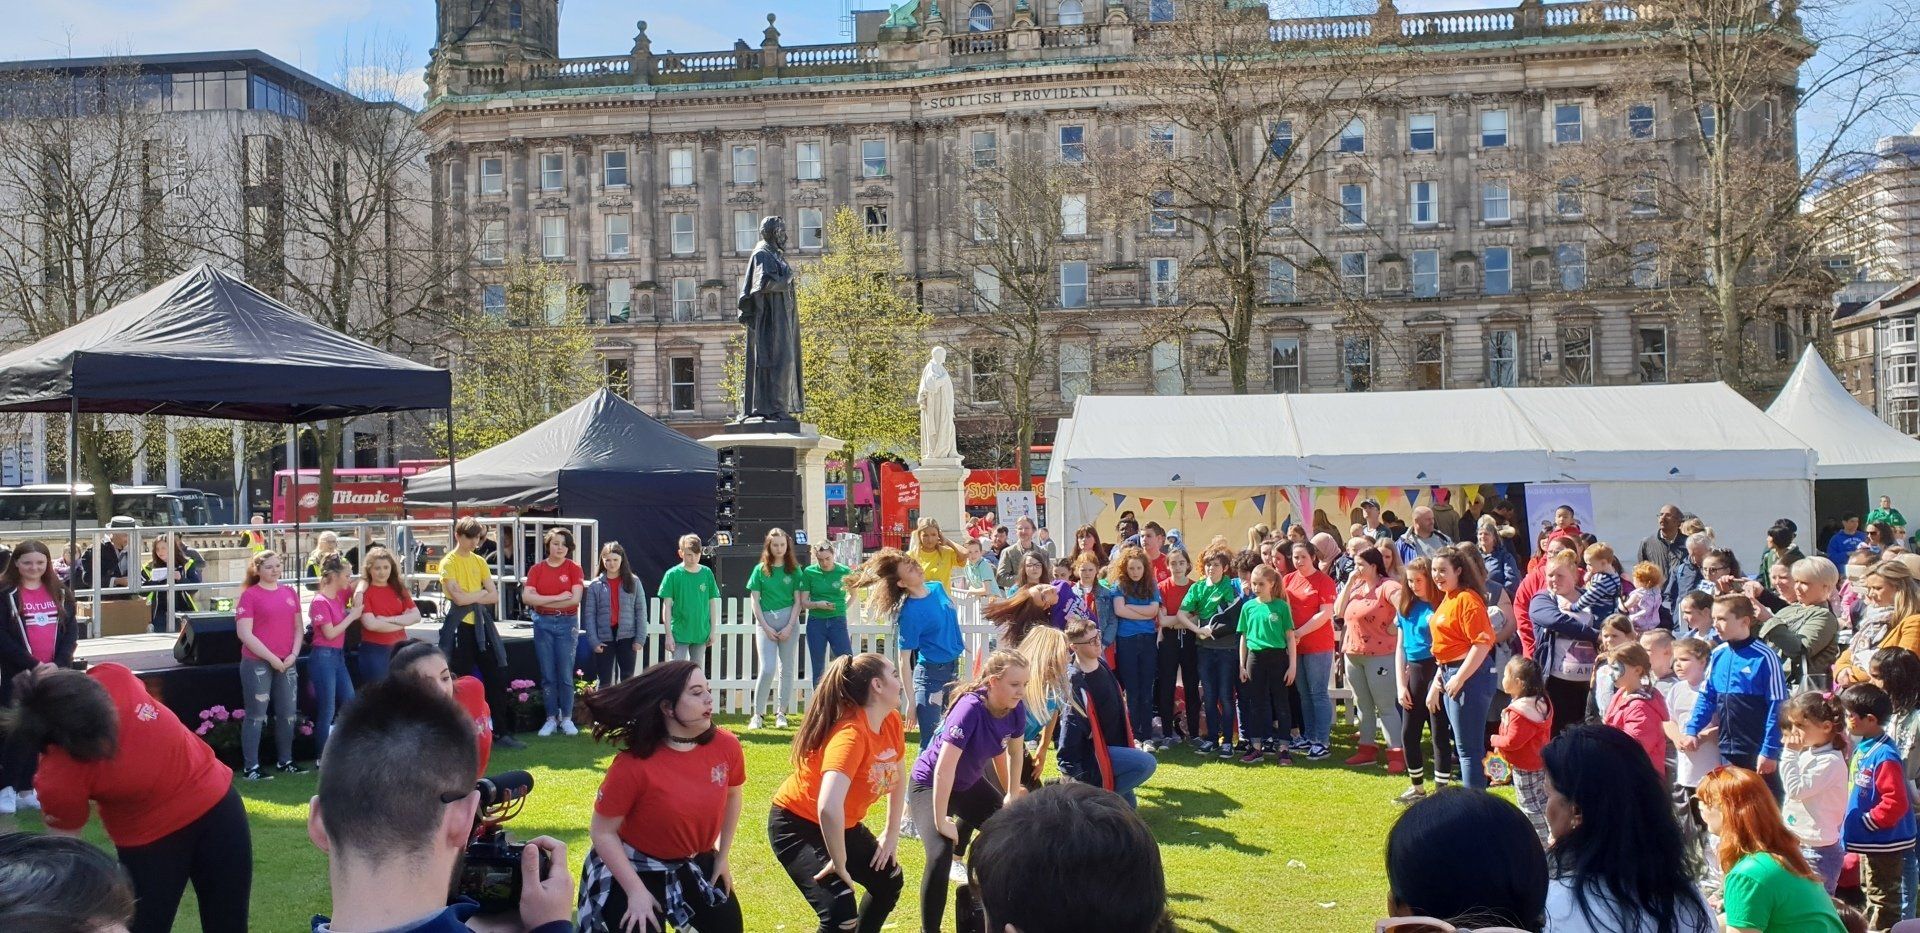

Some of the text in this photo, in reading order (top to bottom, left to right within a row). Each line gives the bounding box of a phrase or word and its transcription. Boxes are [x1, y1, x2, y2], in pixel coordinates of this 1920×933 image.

[930, 91, 1003, 109] SCOTTISH
[1013, 86, 1101, 102] PROVIDENT
[174, 136, 187, 198] Bank
[332, 490, 390, 505] Titanic
